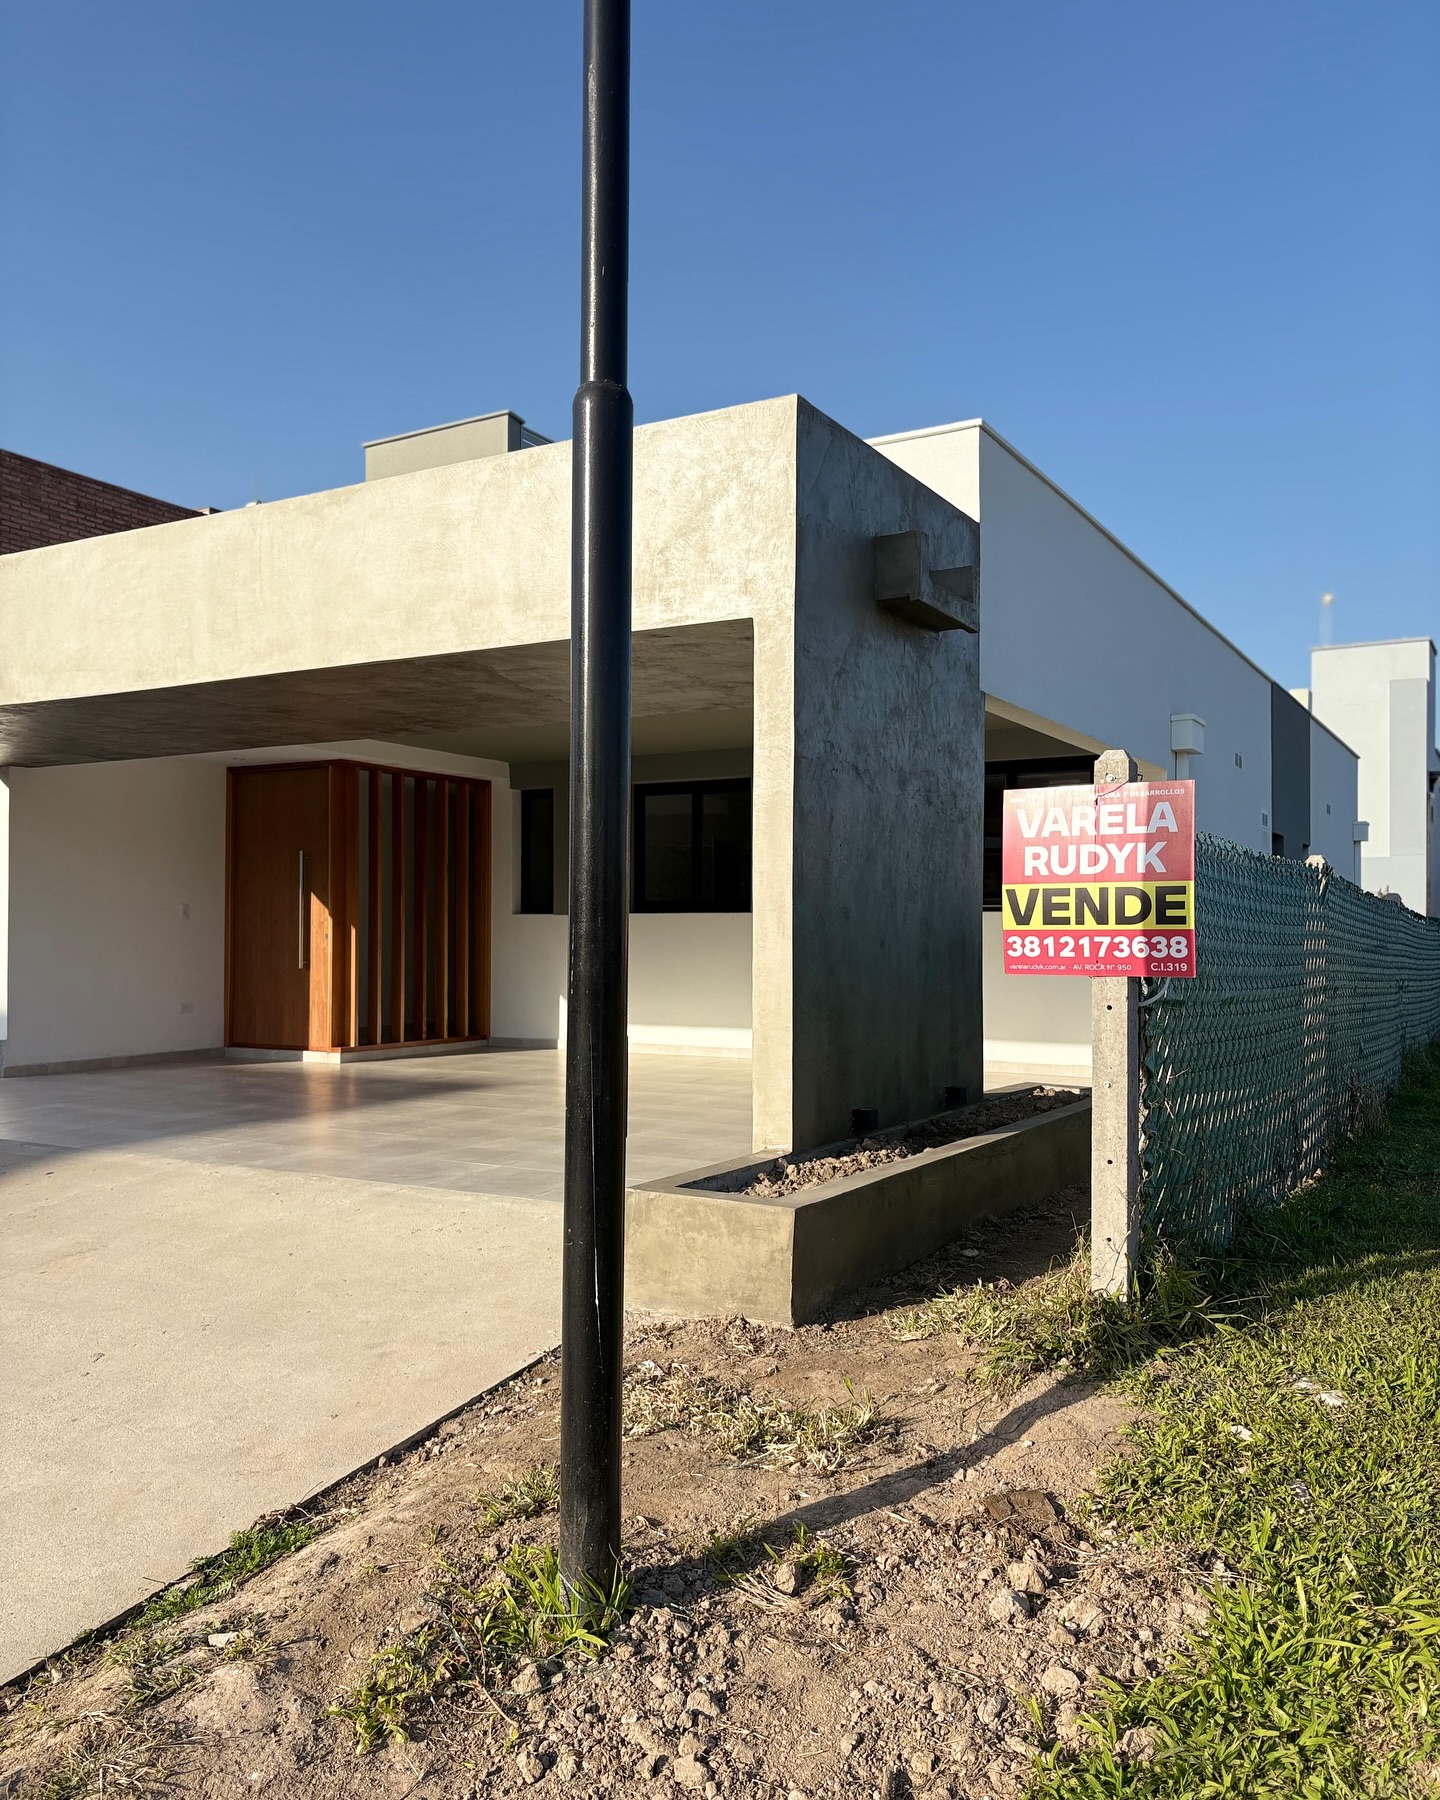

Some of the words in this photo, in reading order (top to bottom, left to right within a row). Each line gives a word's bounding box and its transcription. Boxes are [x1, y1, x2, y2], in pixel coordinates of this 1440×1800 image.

[1130, 788, 1185, 797] DESARROLLOS
[1016, 801, 1178, 838] VARELA
[1024, 841, 1168, 876] RUDYK
[1005, 885, 1187, 926] VENDE
[1006, 935, 1189, 958] 3812173638
[1008, 963, 1067, 971] varelarudyk.com.ar
[1084, 963, 1106, 971] ROCA
[1116, 963, 1132, 971] 950
[1150, 962, 1188, 972] C.I.319
